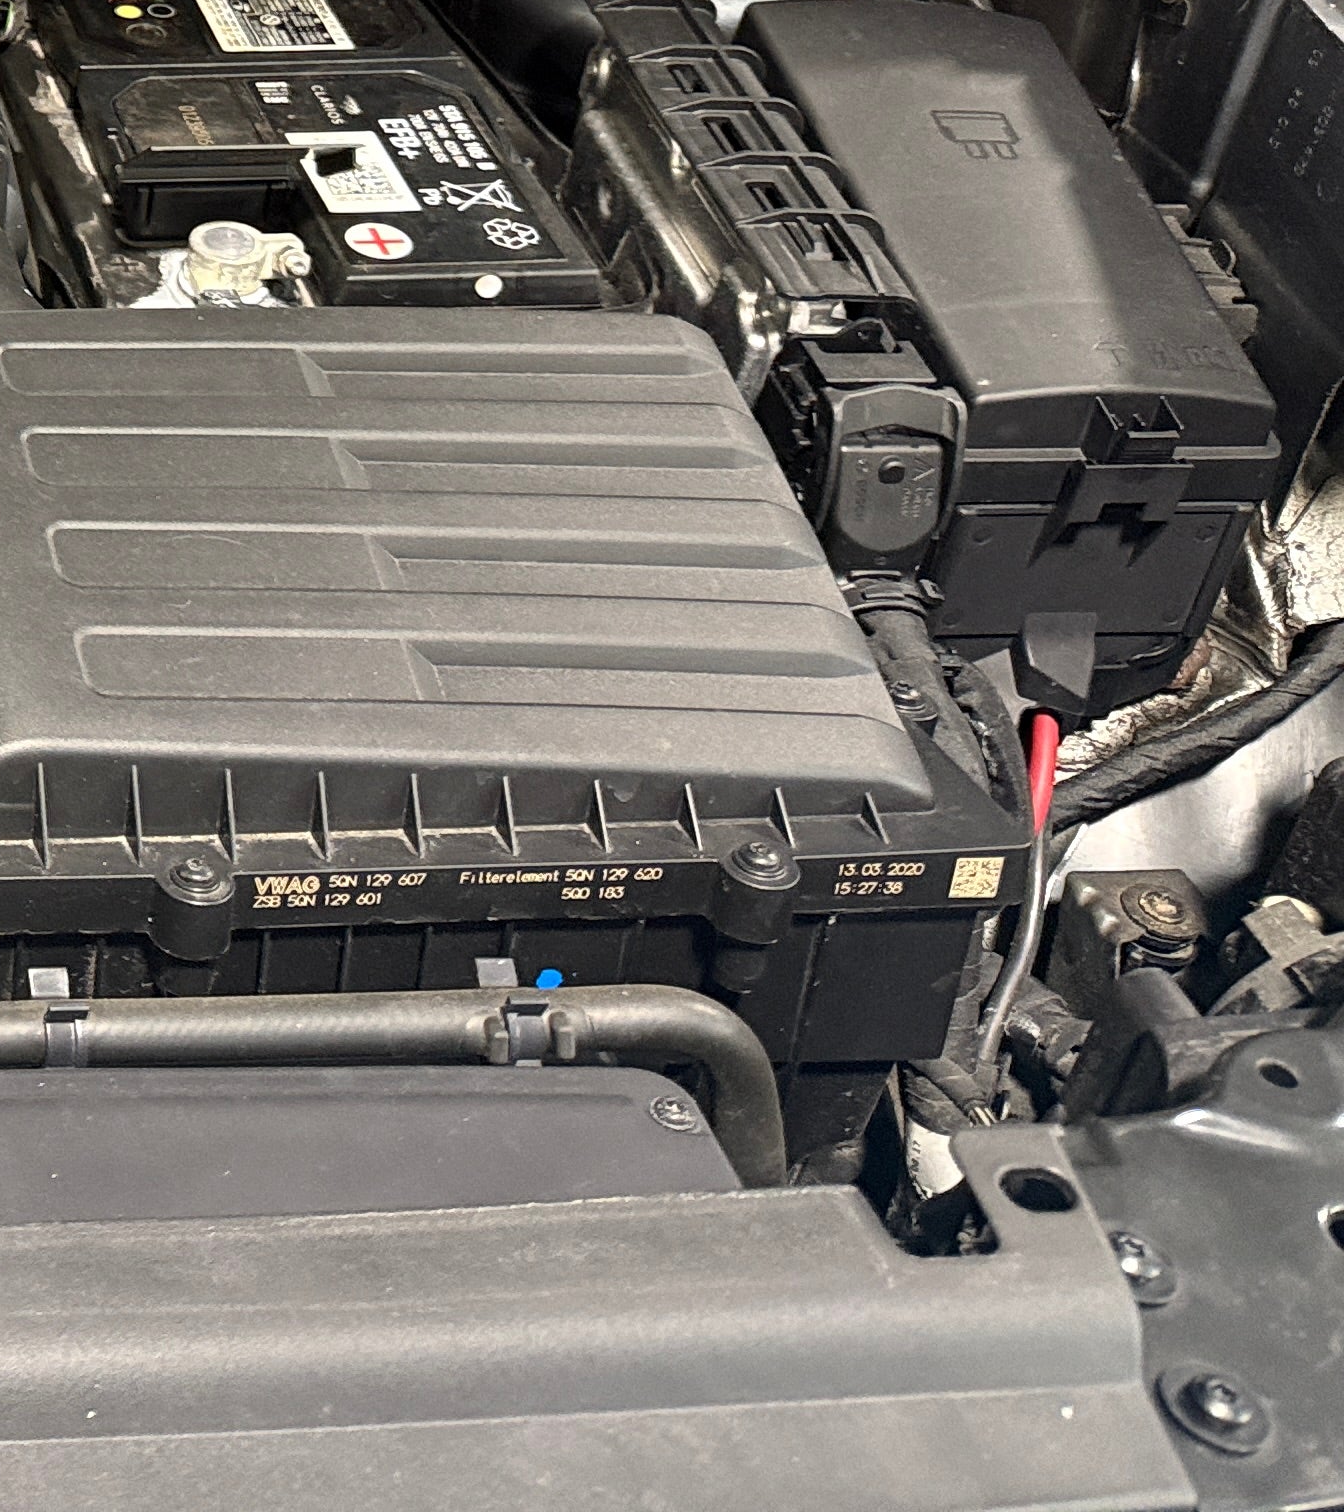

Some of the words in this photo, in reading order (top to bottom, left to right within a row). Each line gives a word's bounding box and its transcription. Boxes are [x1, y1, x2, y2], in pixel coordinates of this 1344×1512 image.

[311, 84, 345, 125] CLARIOS
[377, 117, 423, 160] EFB+
[417, 187, 445, 206] Pb
[254, 875, 321, 895] VWAG
[328, 874, 358, 888] 5QN
[366, 873, 393, 887] 129
[398, 872, 428, 886] 607
[459, 870, 560, 884] Filterelement
[564, 868, 595, 882] 5QN
[602, 867, 630, 882] 129
[633, 867, 664, 881] 620
[598, 886, 626, 899] 183
[833, 881, 904, 895] 15:27:38
[252, 894, 282, 909] ZSB
[287, 894, 317, 908] 5QN
[324, 893, 351, 906] 129
[355, 892, 382, 905] 601
